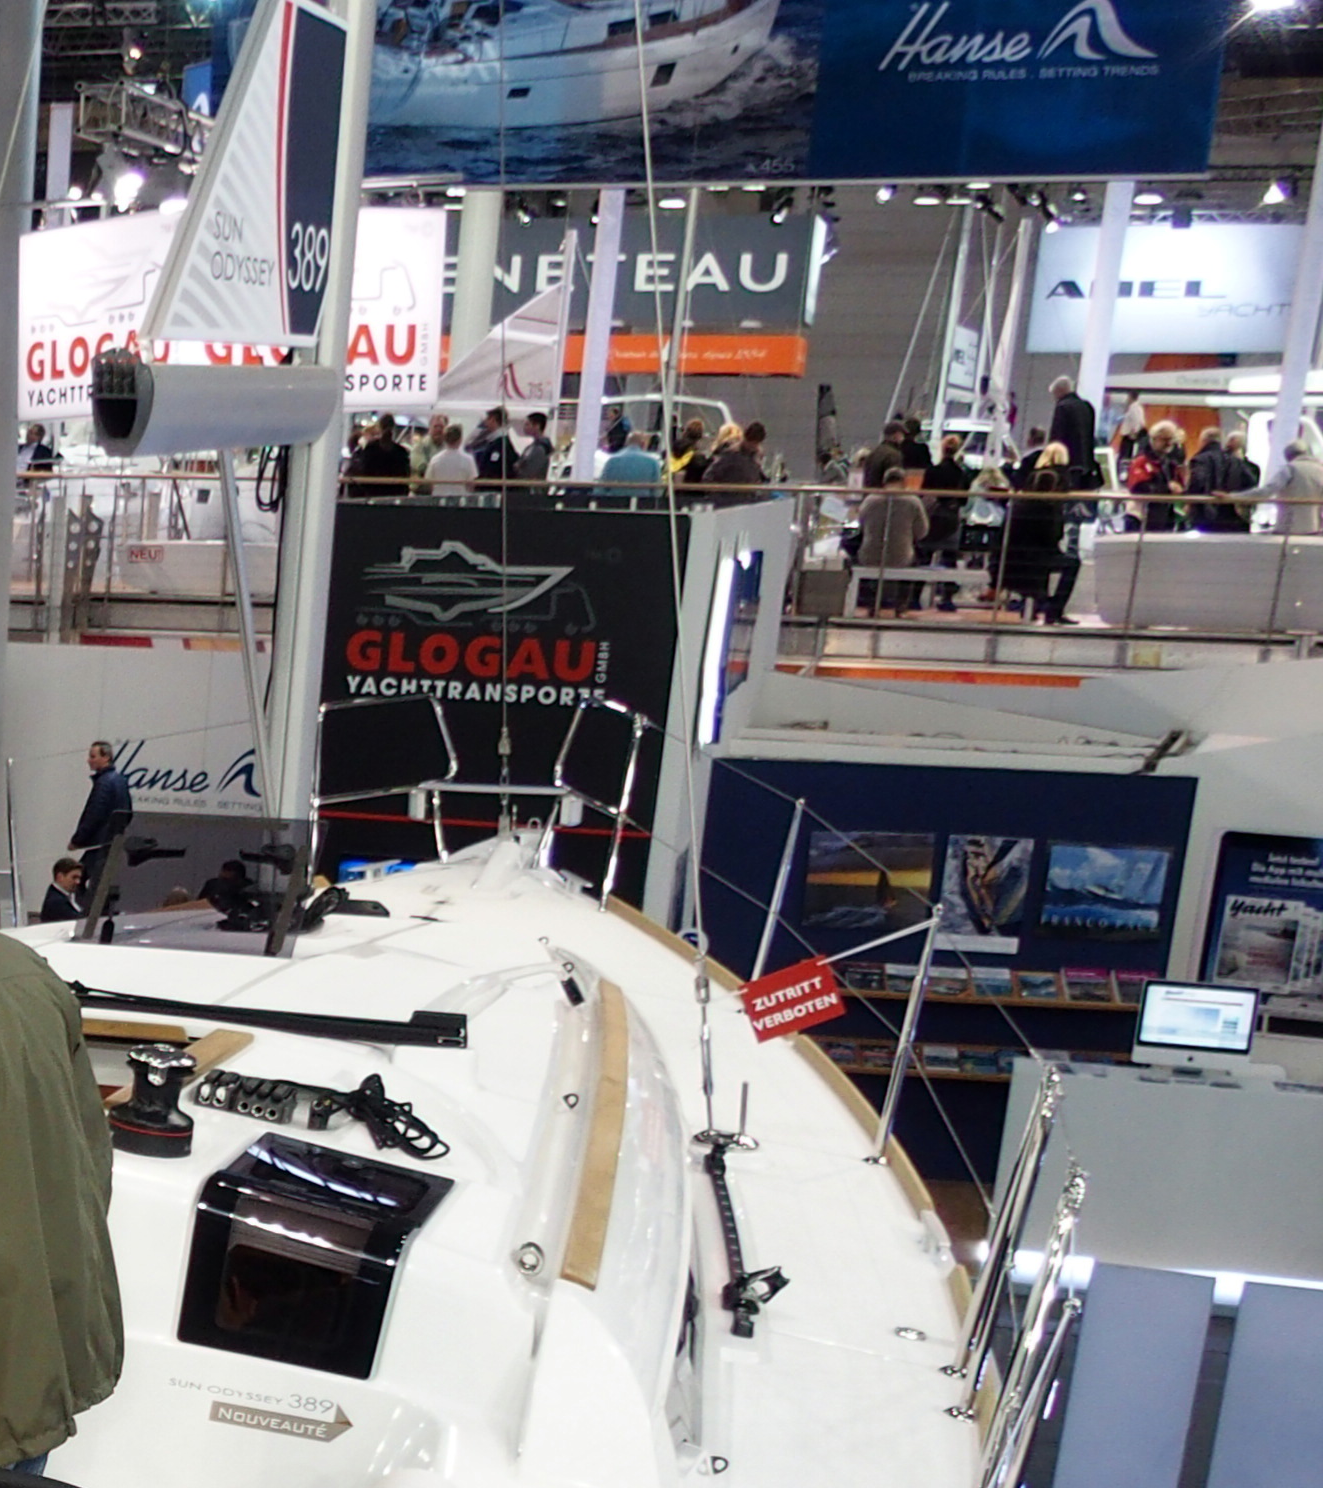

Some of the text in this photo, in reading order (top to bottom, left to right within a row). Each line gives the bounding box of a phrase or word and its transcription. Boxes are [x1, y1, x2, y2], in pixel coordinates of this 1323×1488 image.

[878, 1, 1032, 71] Hanse
[908, 64, 1160, 83] BREAKING RULES SETTING TRENDS
[213, 210, 244, 243] SUN
[211, 250, 275, 287] ODYSSEY
[288, 222, 330, 293] 389
[345, 629, 596, 682] GLOGAU
[595, 641, 610, 684] GMBH
[346, 675, 606, 707] YACHTTRANSPORTE
[752, 976, 822, 1011] ZUTRITT
[753, 993, 838, 1031] VERBOTEN
[168, 1377, 335, 1415] SUN ODYSSEY 389
[217, 1407, 327, 1438] NOUVEAUTÉ
